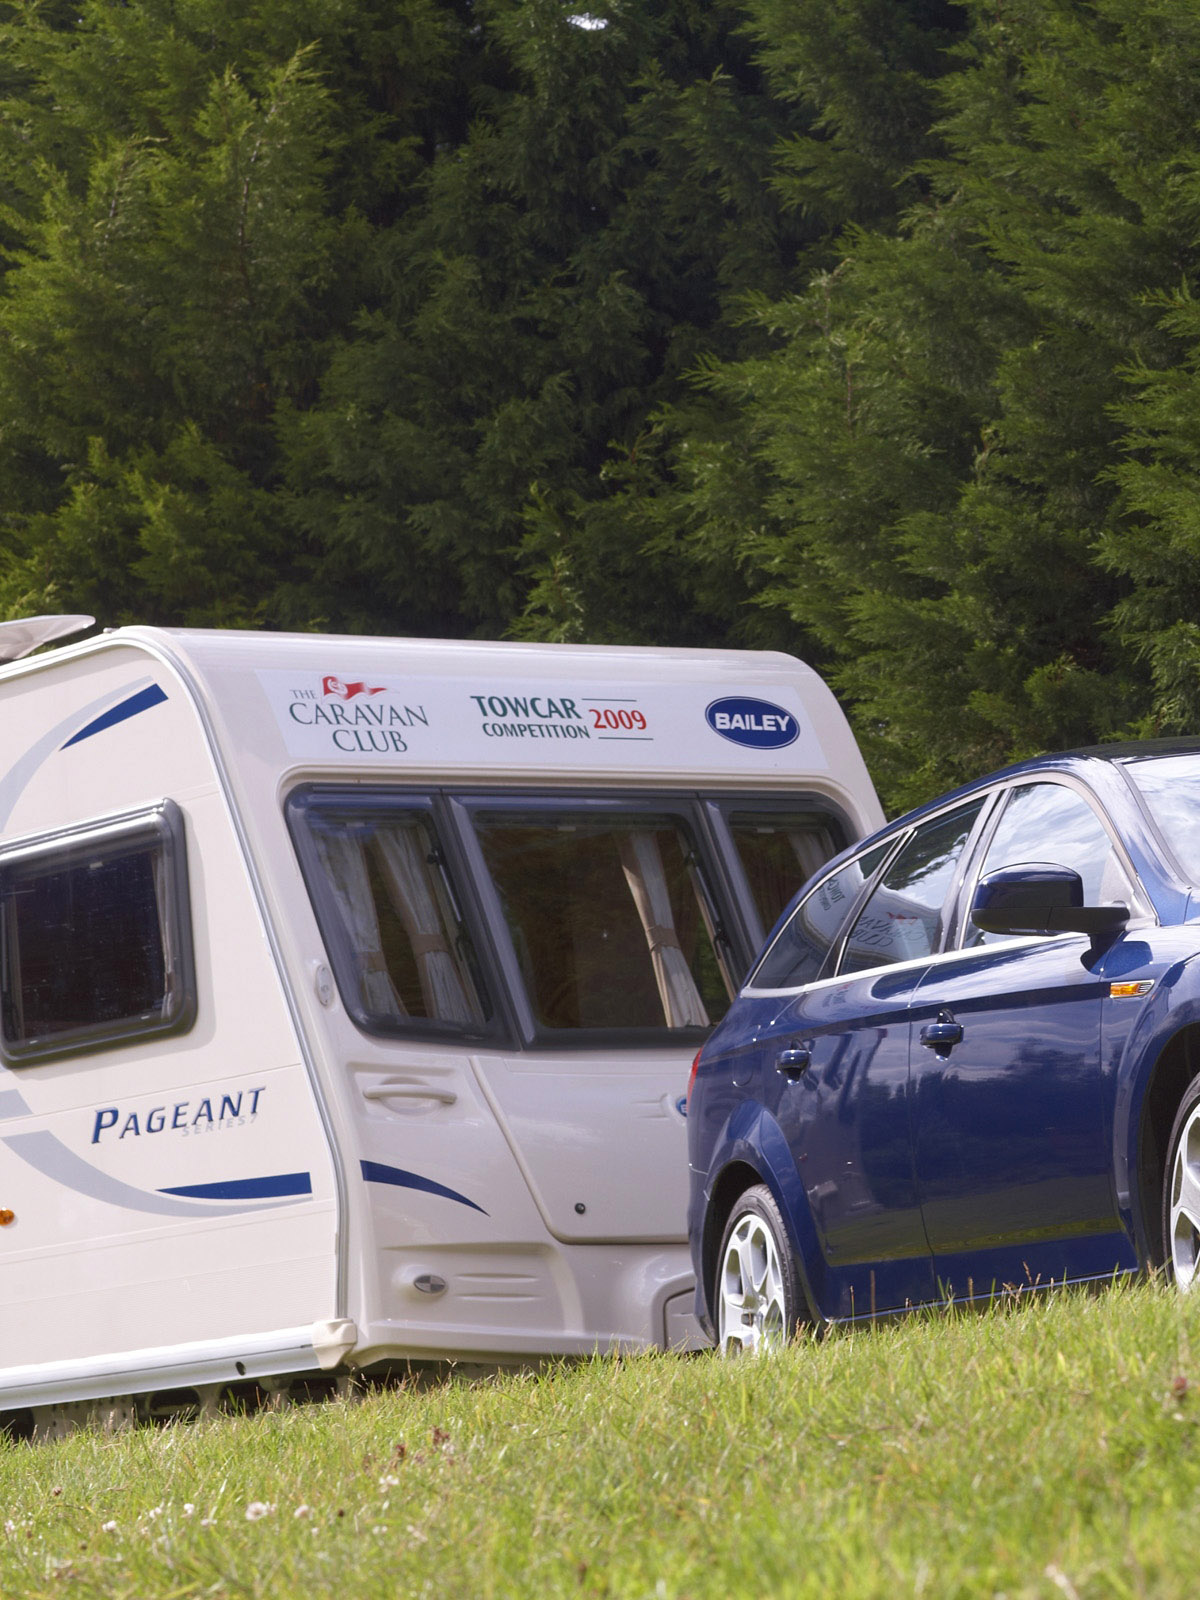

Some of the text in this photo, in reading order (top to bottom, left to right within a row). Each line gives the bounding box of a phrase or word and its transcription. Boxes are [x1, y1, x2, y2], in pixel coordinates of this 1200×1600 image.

[289, 689, 317, 699] THE
[289, 702, 430, 727] CARAVAN
[470, 695, 583, 719] TOWCAR
[482, 722, 591, 739] COMPETITION
[588, 709, 647, 730] 2009
[714, 712, 790, 732] BAILEY
[332, 729, 408, 753] CLUB
[91, 1085, 266, 1144] PAGEANT
[182, 1115, 246, 1137] SERIES
